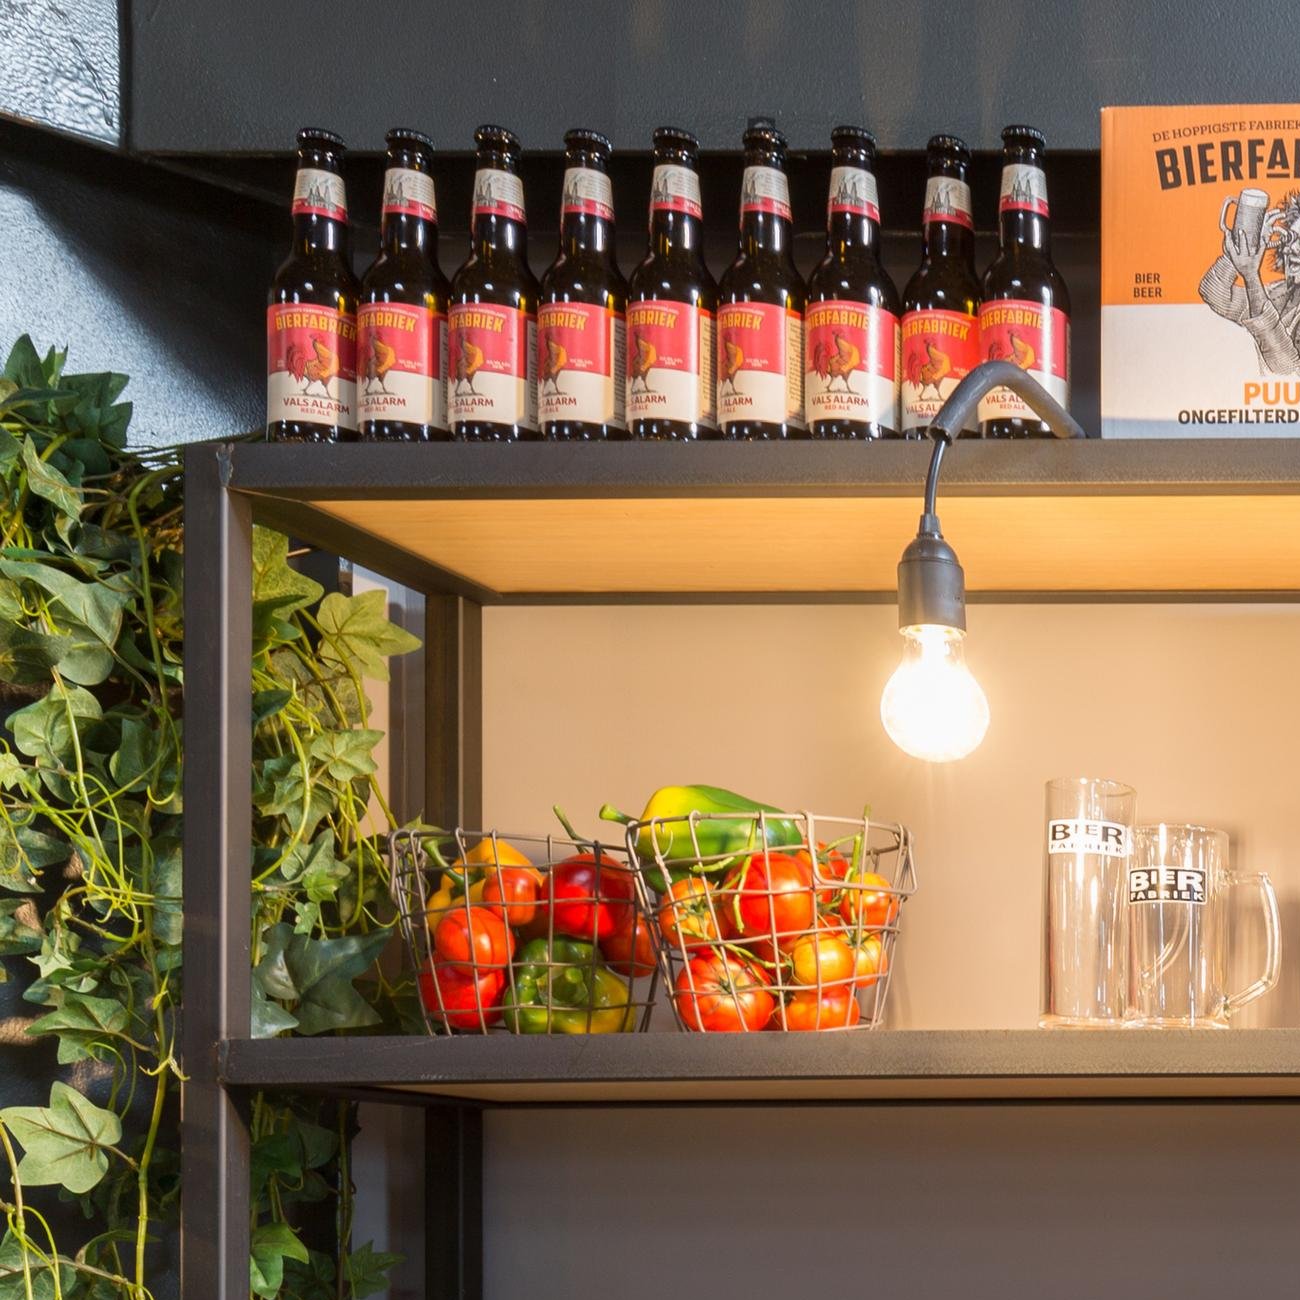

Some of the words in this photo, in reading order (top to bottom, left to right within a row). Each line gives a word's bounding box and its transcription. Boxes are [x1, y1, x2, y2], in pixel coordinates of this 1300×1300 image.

[1152, 131, 1170, 143] DE
[1173, 121, 1247, 139] HOPPIGSTE
[1134, 272, 1161, 284] BIER
[1134, 286, 1162, 298] BEER
[370, 397, 406, 406] ALARM
[460, 398, 494, 408] ALARM
[546, 396, 576, 406] ALARM
[636, 395, 666, 404] ALARM
[812, 396, 832, 406] VALS
[834, 395, 870, 407] ALARM
[986, 394, 1006, 405] VALS
[283, 398, 309, 407] VALS
[312, 400, 350, 416] ALARM
[906, 404, 926, 414] VALS
[1051, 823, 1124, 846] BIER
[1130, 870, 1204, 892] BIER
[1130, 890, 1204, 901] FABRIEK
